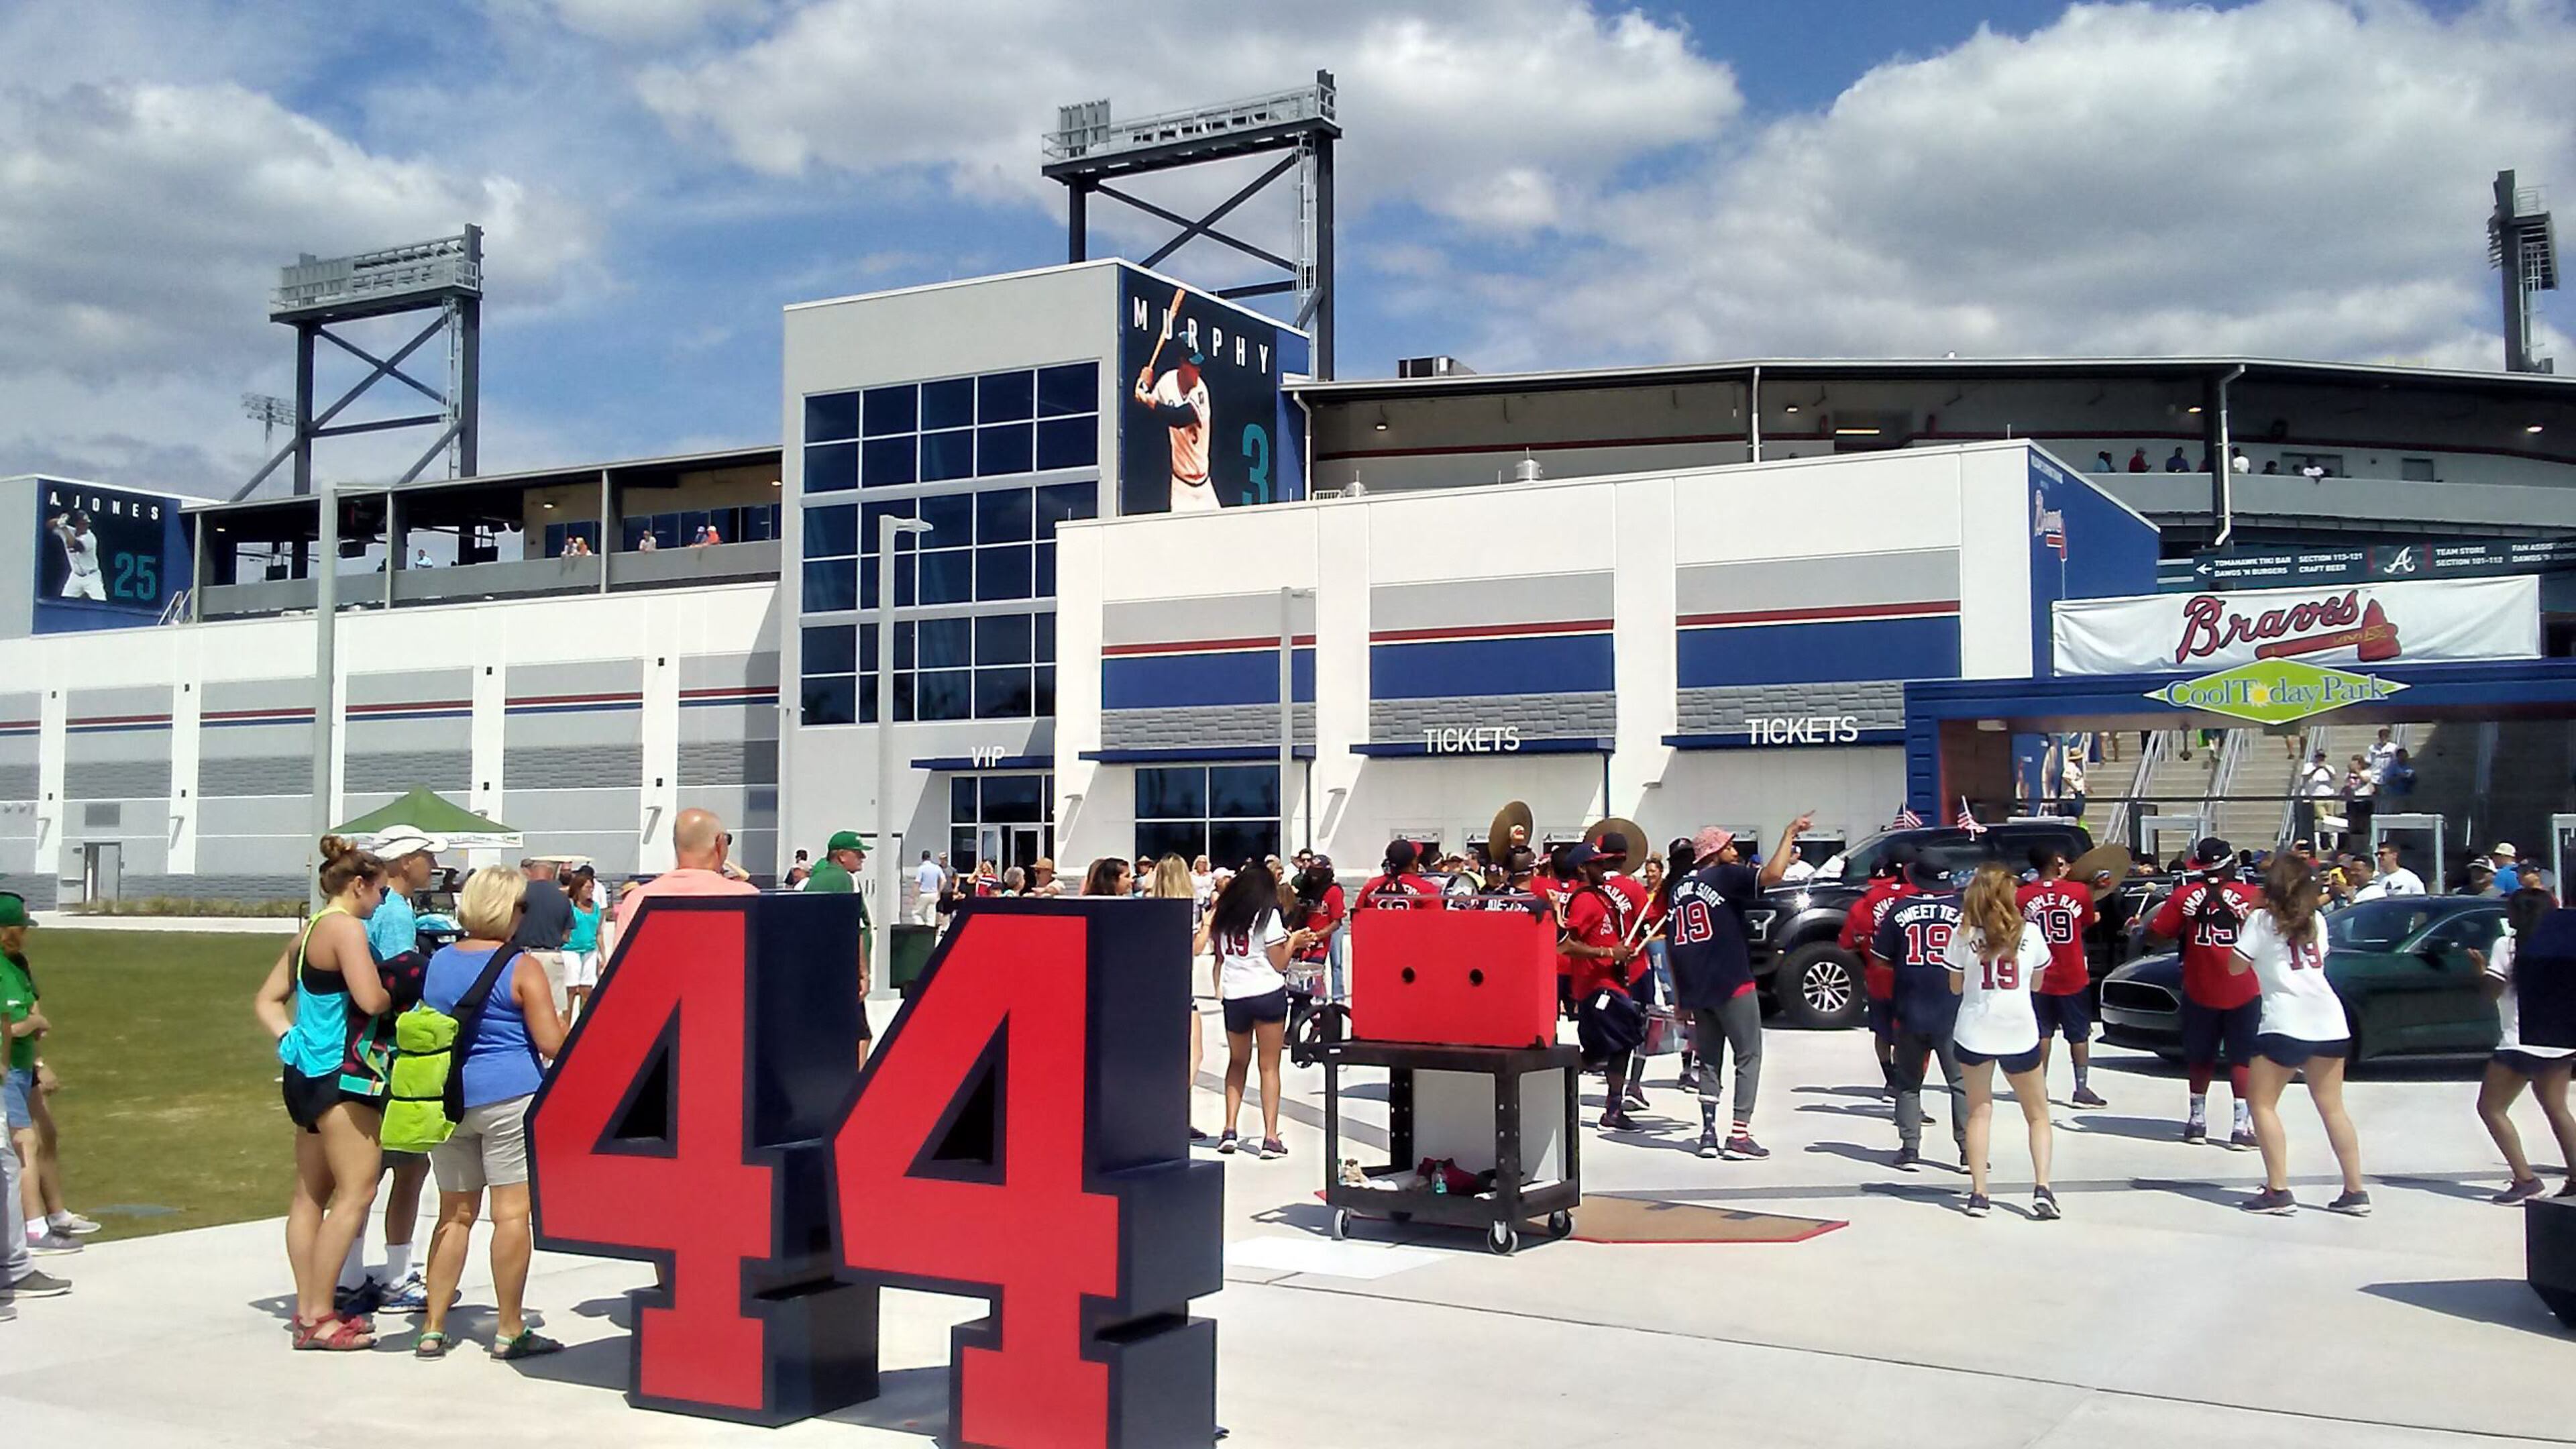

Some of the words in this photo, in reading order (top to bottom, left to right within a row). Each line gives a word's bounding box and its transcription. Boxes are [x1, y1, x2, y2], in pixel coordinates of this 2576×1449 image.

[1134, 296, 1269, 374] MURPHY
[1242, 423, 1269, 505] 3
[74, 495, 159, 520] JONES
[2298, 555, 2332, 563] SECTION
[2436, 547, 2458, 555] TEAM
[2460, 546, 2486, 554] STORE
[114, 551, 156, 600] 25
[2298, 565, 2324, 573] CRAFT
[2176, 589, 2359, 663] Braves
[1424, 727, 1520, 753] TICKETS
[1746, 716, 1858, 745] TICKETS
[971, 746, 1006, 768] VIP
[1695, 882, 1726, 908] SURF
[1674, 900, 1713, 946] 19
[1894, 904, 1937, 927] SWEET
[2034, 909, 2074, 944] 19
[1905, 924, 1953, 966] 19
[2288, 936, 2322, 970] 19
[1980, 954, 2020, 989] 19
